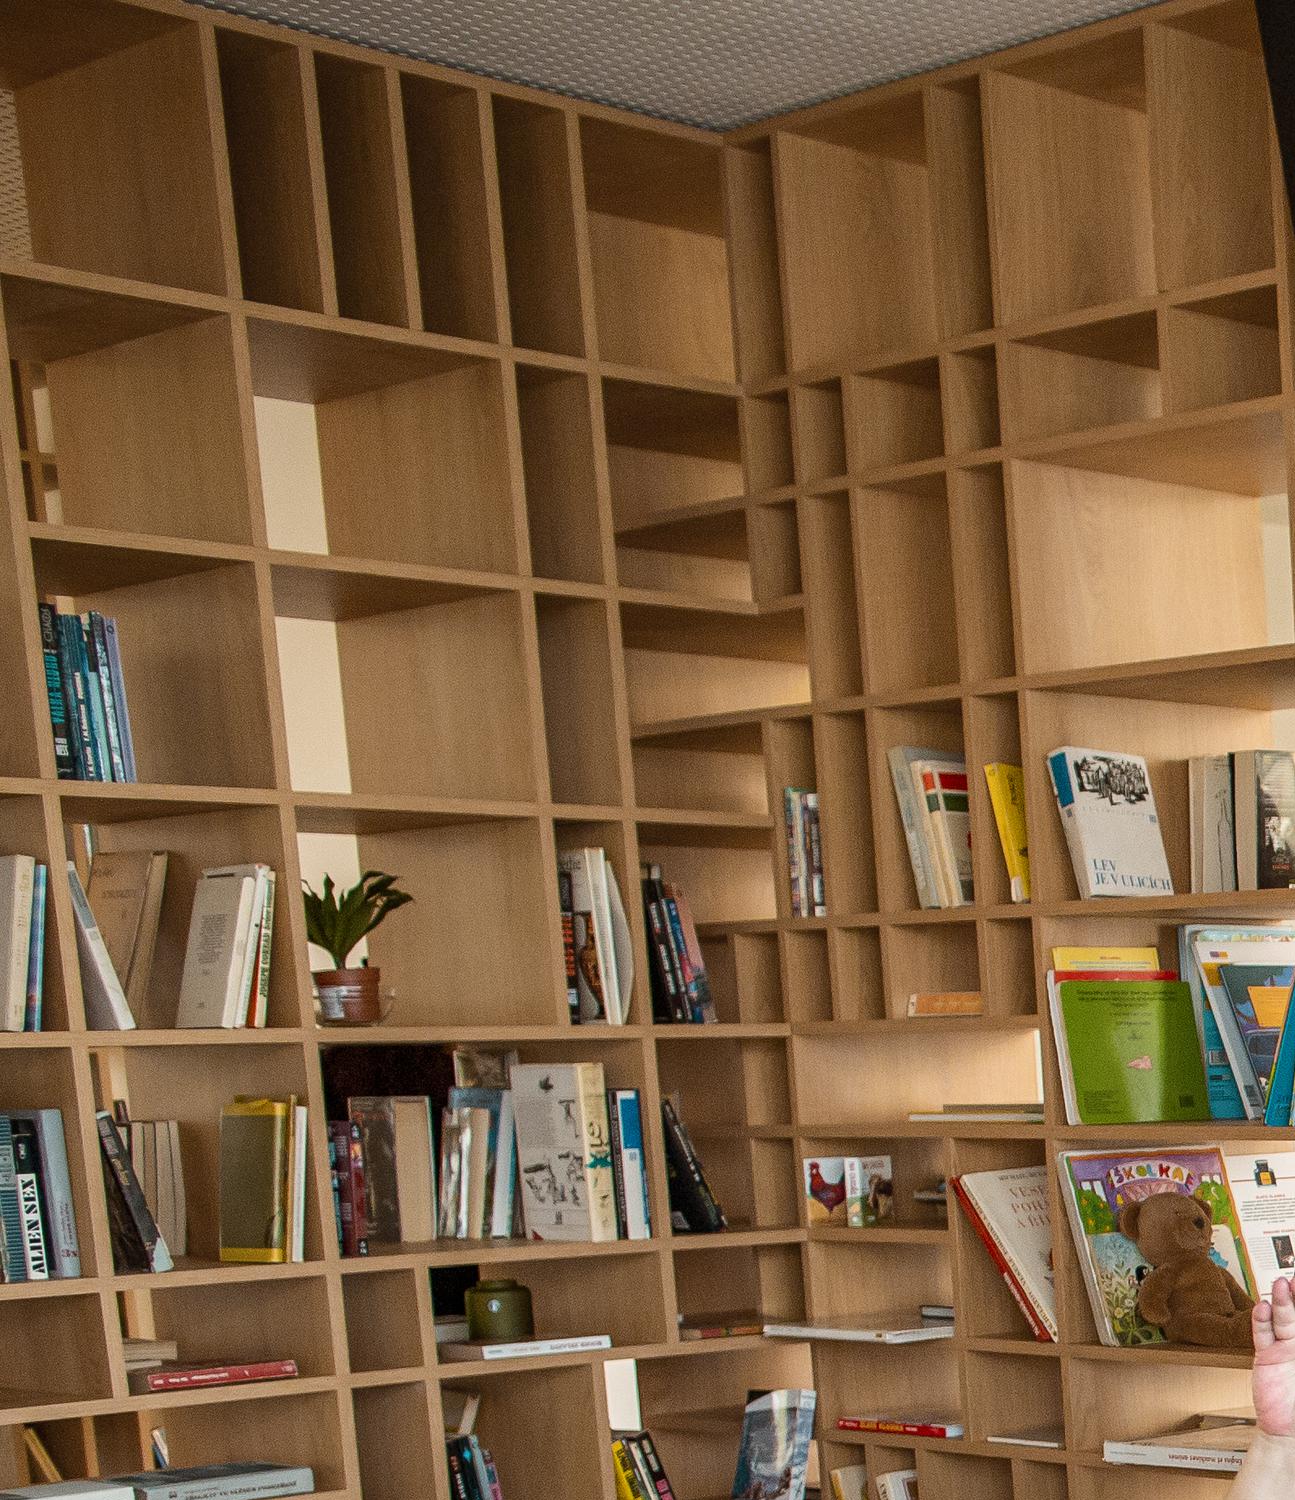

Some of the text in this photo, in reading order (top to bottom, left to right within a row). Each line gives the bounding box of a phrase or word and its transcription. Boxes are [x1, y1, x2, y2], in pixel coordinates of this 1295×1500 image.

[1093, 858, 1117, 872] LEV
[20, 1178, 38, 1216] SEX
[26, 1219, 46, 1275] ALIEN
